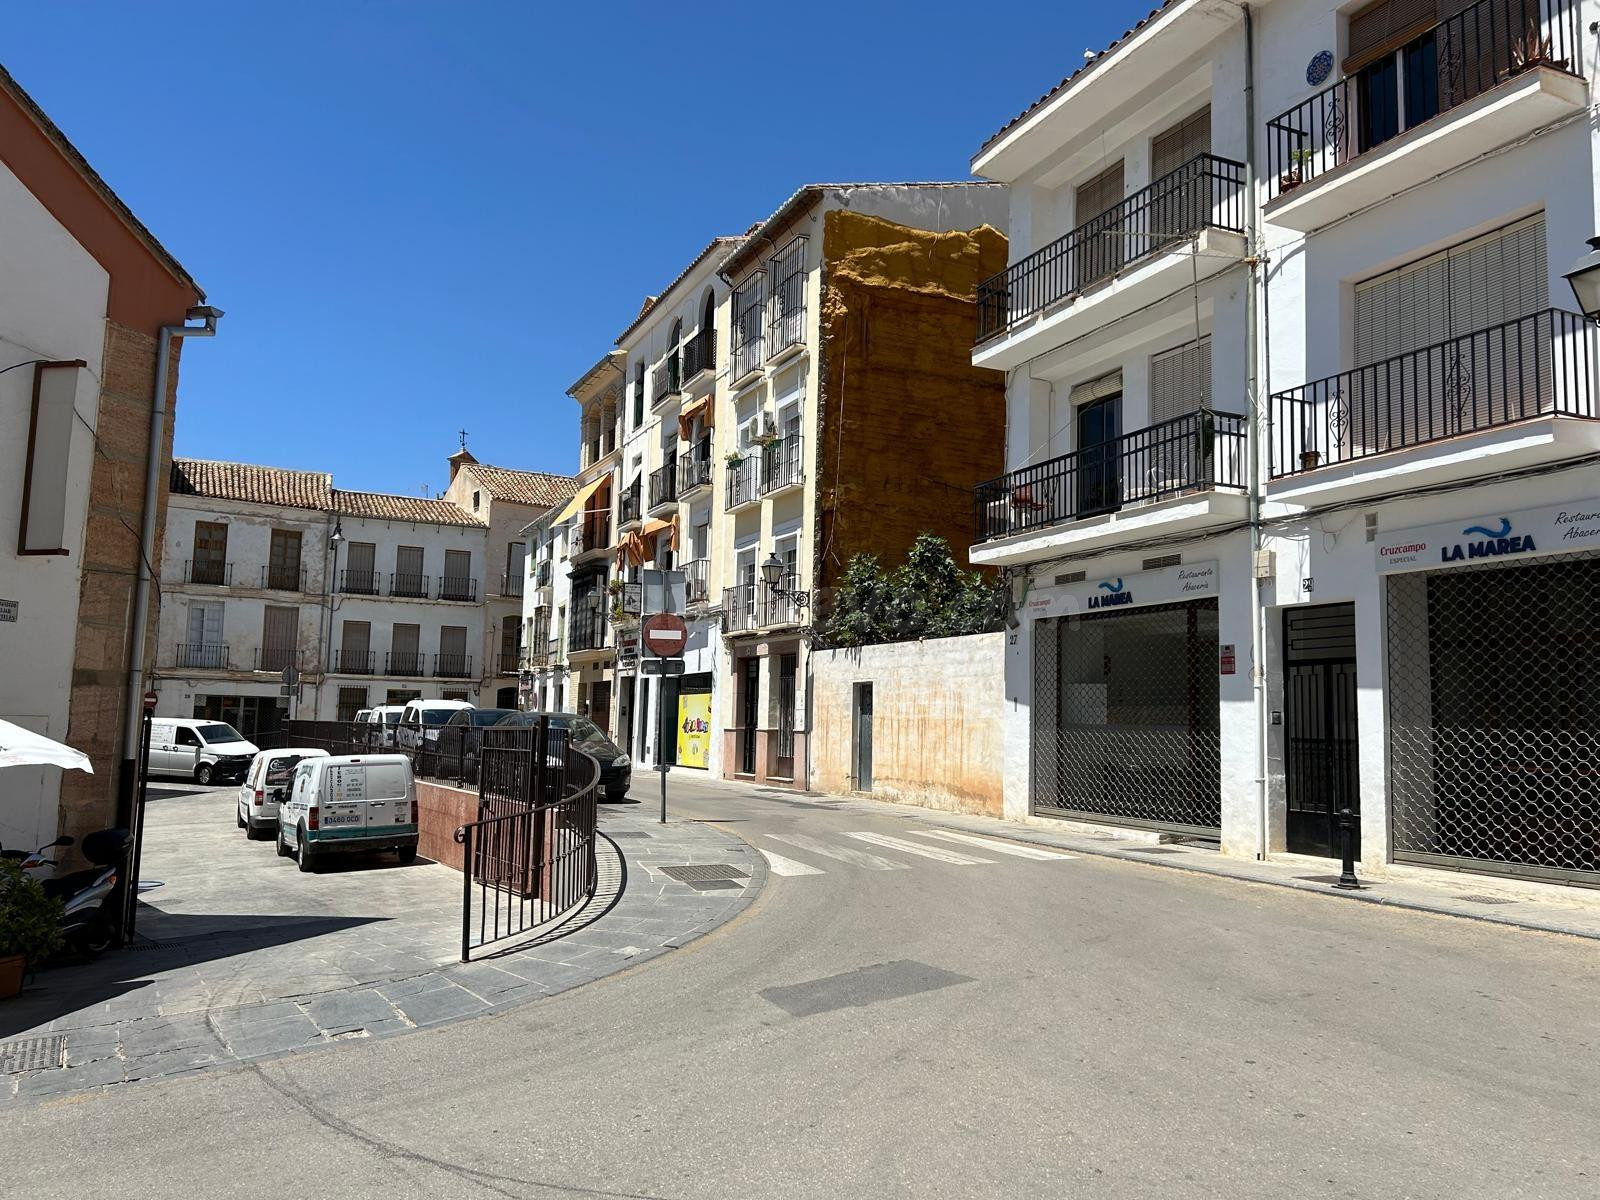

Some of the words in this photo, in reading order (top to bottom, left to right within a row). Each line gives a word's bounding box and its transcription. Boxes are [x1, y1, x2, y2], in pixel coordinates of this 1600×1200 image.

[1380, 542, 1427, 556] Cruzcampo
[1441, 544, 1465, 562] LA
[1468, 535, 1537, 559] MAREA
[1389, 556, 1417, 565] ESPECIAL
[1303, 578, 1314, 592] 29
[1088, 597, 1100, 609] LA
[1101, 591, 1133, 607] MAREA
[1009, 634, 1018, 645] 27
